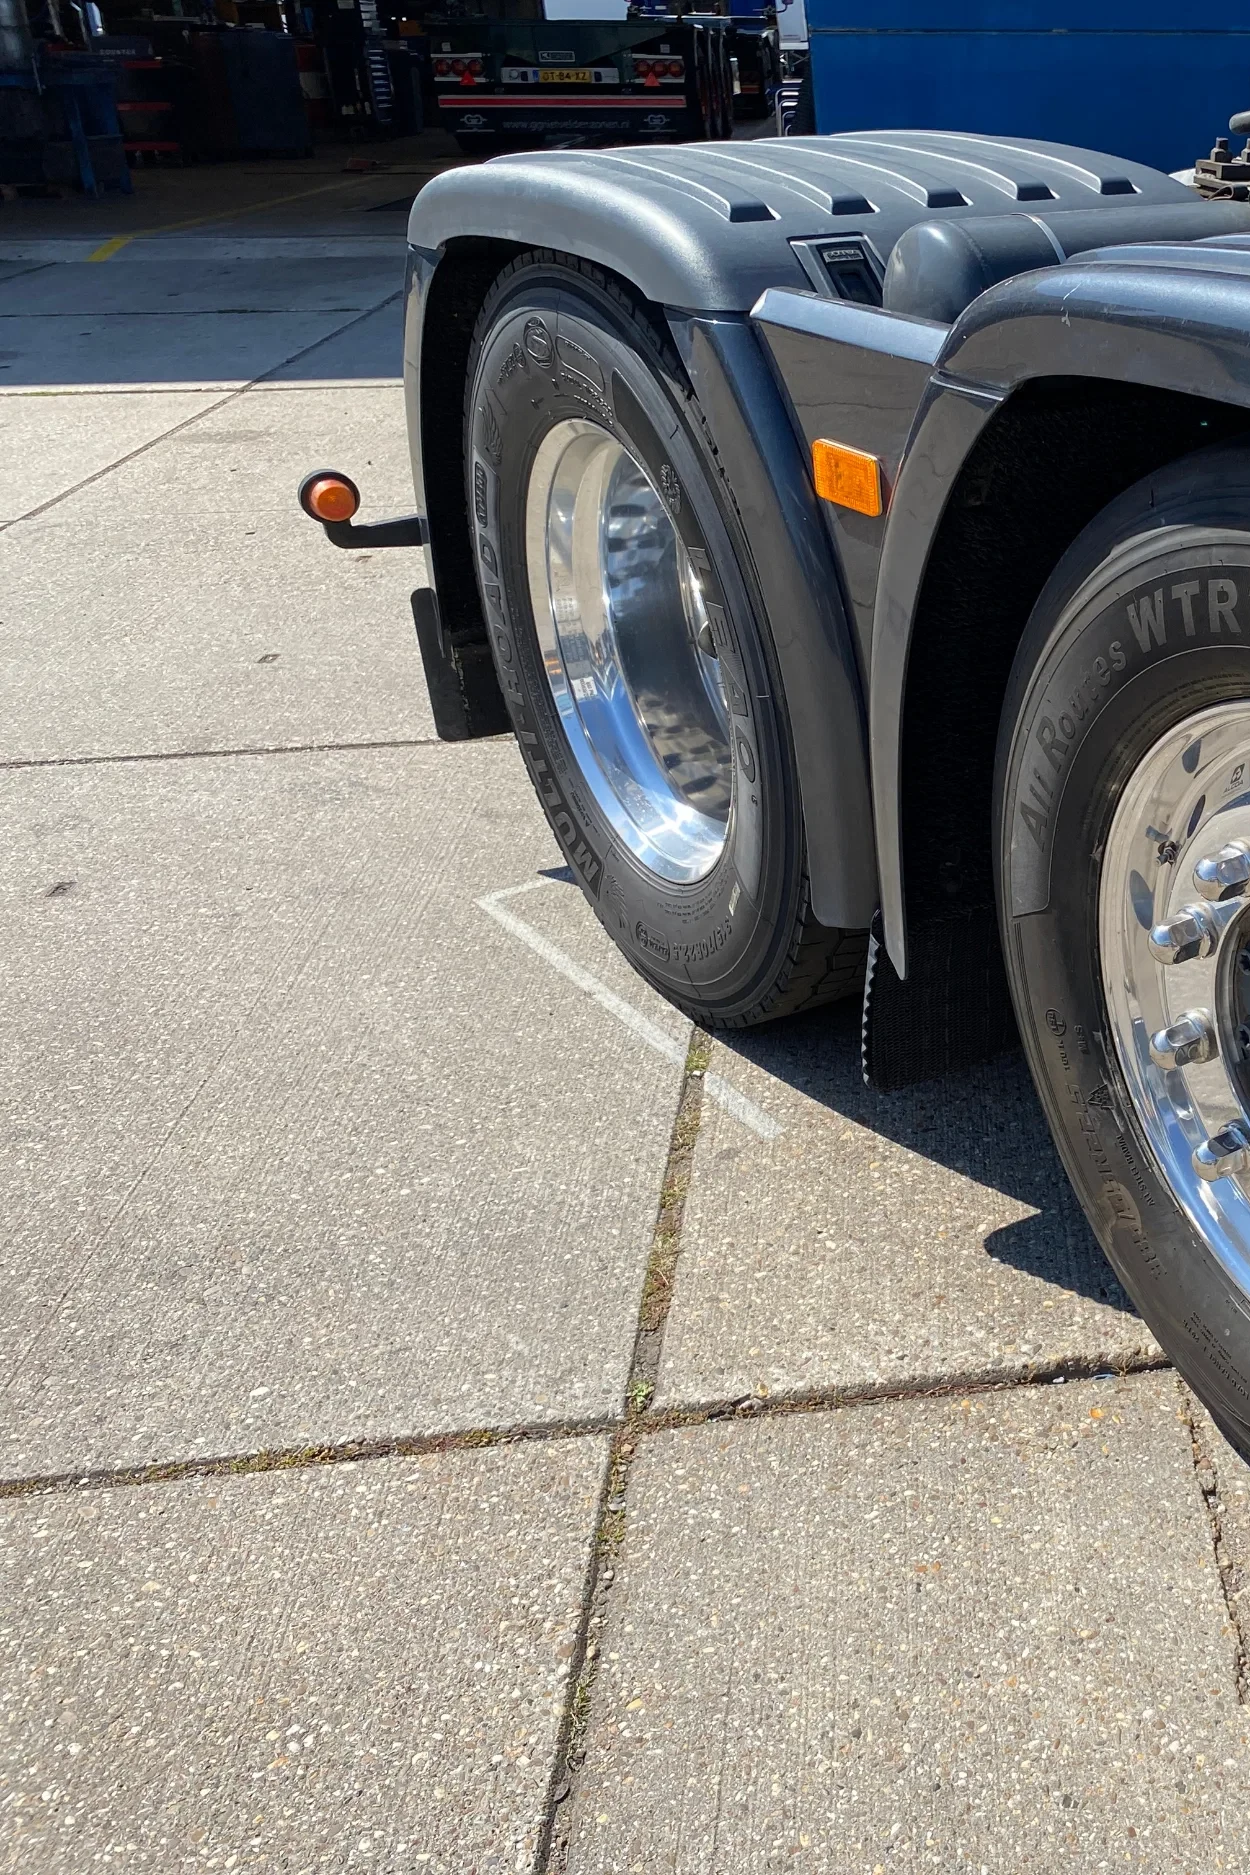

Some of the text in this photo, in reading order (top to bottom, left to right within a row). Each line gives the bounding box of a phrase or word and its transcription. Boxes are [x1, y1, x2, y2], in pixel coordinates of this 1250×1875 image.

[1036, 641, 1127, 772] Routes
[1114, 1133, 1135, 1166] RADIAL
[1128, 1164, 1148, 1193] STEEL
